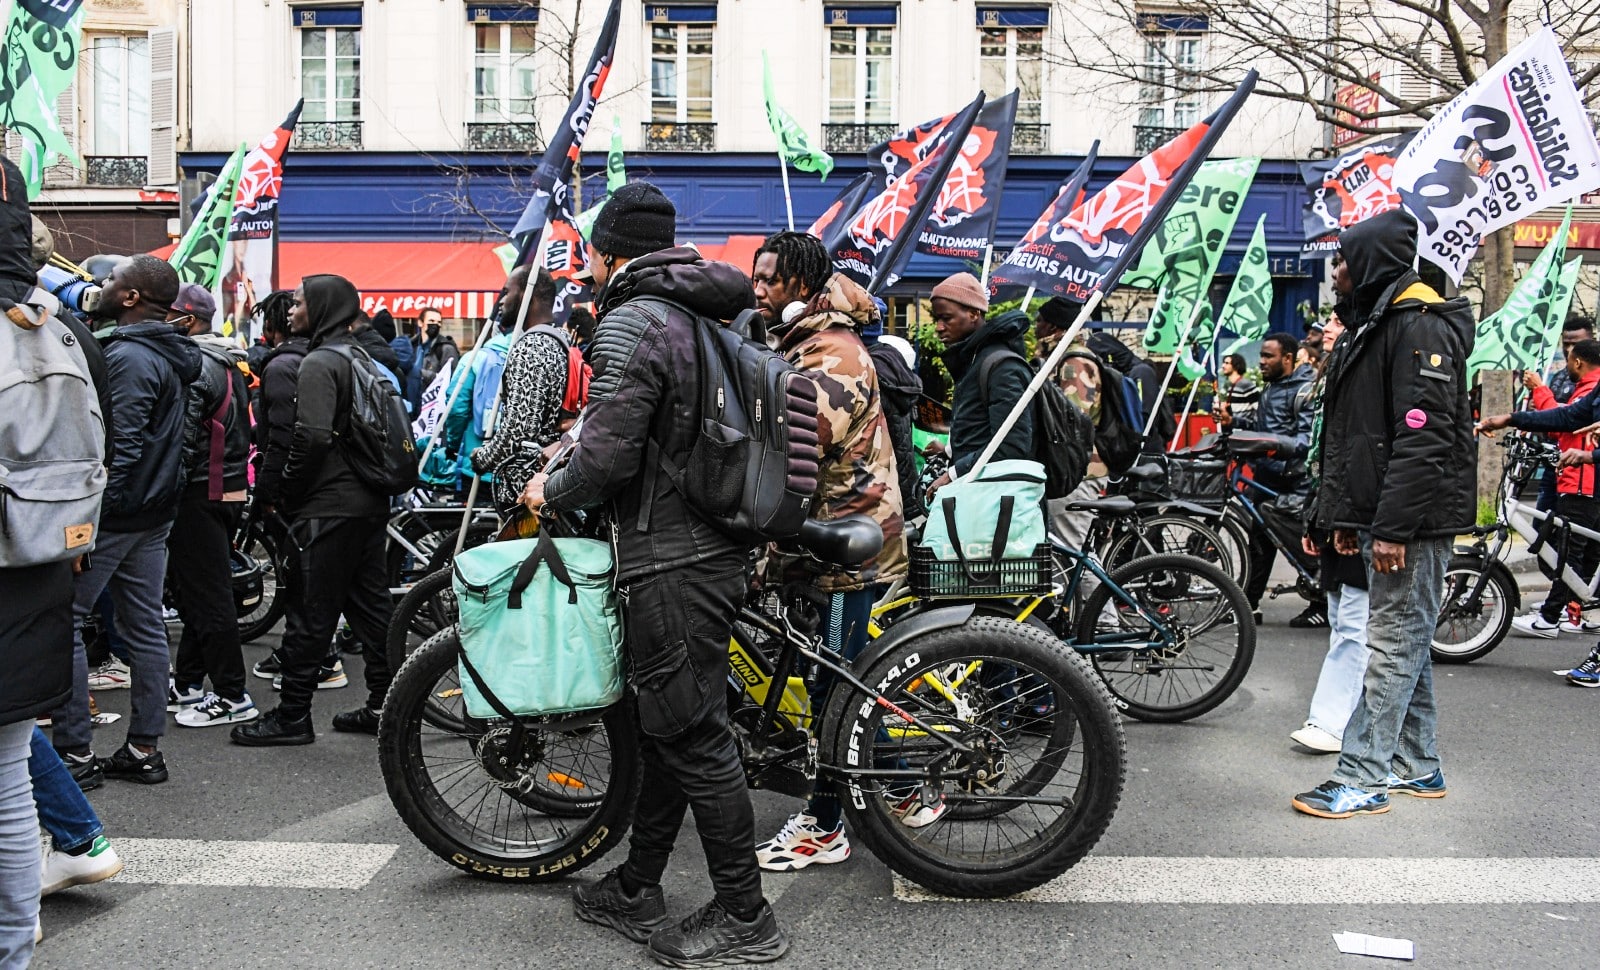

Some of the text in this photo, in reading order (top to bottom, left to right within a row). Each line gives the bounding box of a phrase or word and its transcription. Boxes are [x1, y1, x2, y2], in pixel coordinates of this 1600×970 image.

[655, 7, 665, 16] 1K
[835, 10, 845, 20] 1K
[987, 11, 997, 20] 1K
[1343, 163, 1370, 194] CLAP
[928, 233, 988, 249] AUTONOME
[1304, 240, 1341, 251] LIVREU
[1271, 258, 1306, 274] TEL
[1060, 264, 1103, 288] AUT
[730, 653, 759, 684] WIND
[847, 720, 865, 766] BFT
[451, 825, 610, 878] CST BFT 26x4.0
